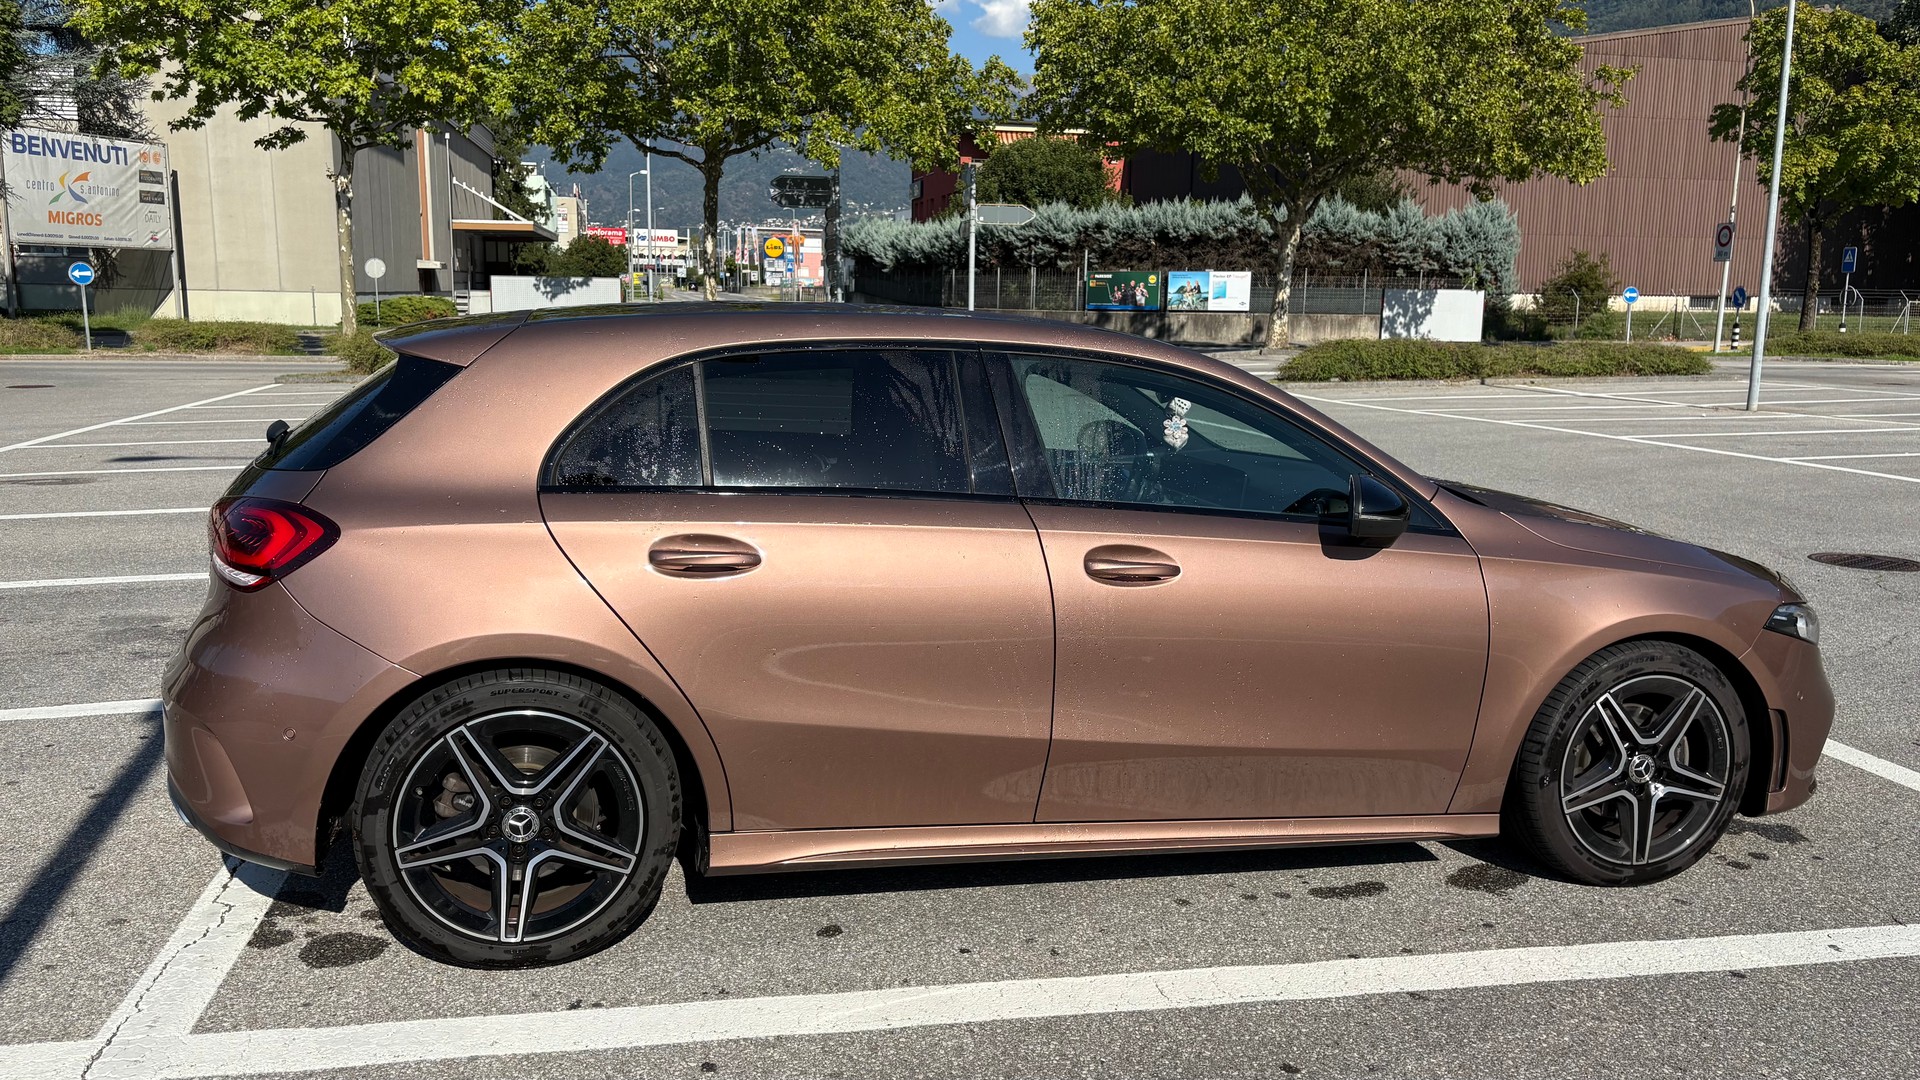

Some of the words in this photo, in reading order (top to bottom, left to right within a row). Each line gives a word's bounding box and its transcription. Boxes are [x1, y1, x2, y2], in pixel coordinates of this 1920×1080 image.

[12, 133, 128, 166] BENVENUTI
[26, 179, 55, 191] centro
[80, 184, 120, 197] s.antonino
[48, 210, 103, 226] MIGROS
[145, 214, 161, 223] DAILY
[490, 688, 560, 697] SUPERSPORT
